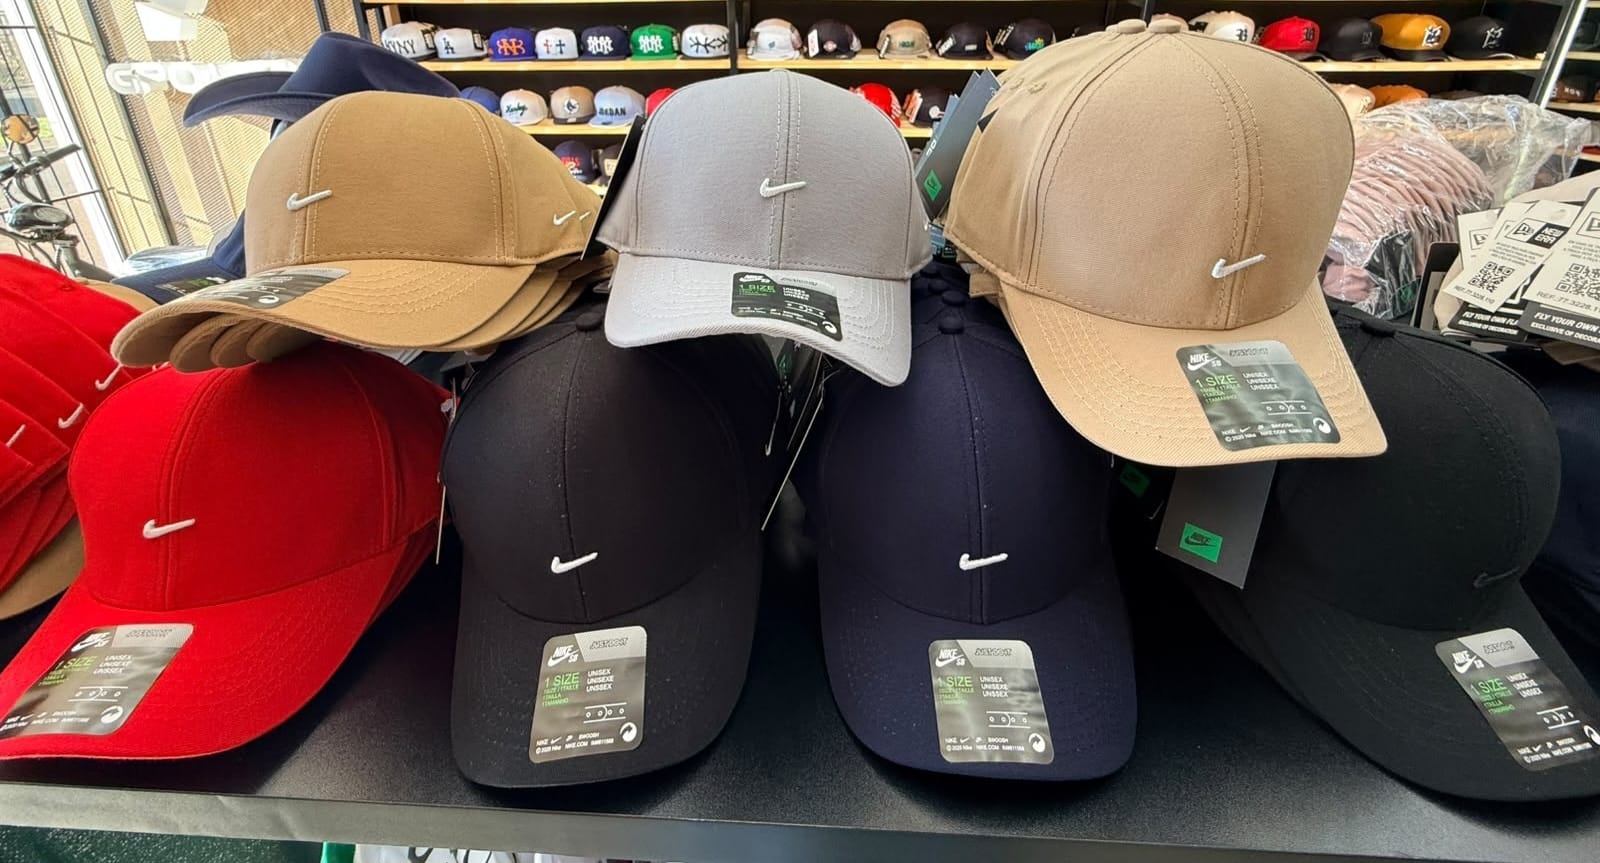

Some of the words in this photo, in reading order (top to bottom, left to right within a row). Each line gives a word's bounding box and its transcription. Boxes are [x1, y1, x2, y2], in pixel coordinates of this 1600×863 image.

[1531, 321, 1564, 335] EXCLUSIVE
[1534, 312, 1551, 321] FLY
[1550, 315, 1576, 327] YOUR
[1575, 321, 1599, 333] OWN
[1190, 352, 1209, 363] NIKE
[1205, 374, 1238, 387] SIZE
[554, 645, 574, 656] NIKE
[939, 648, 958, 659] NIKE
[64, 655, 99, 669] SIZE
[588, 668, 611, 677] UNISEX
[553, 672, 580, 687] SIZE
[586, 675, 614, 685] UNISEXE
[946, 676, 973, 687] SIZE
[1478, 678, 1508, 694] SIZE
